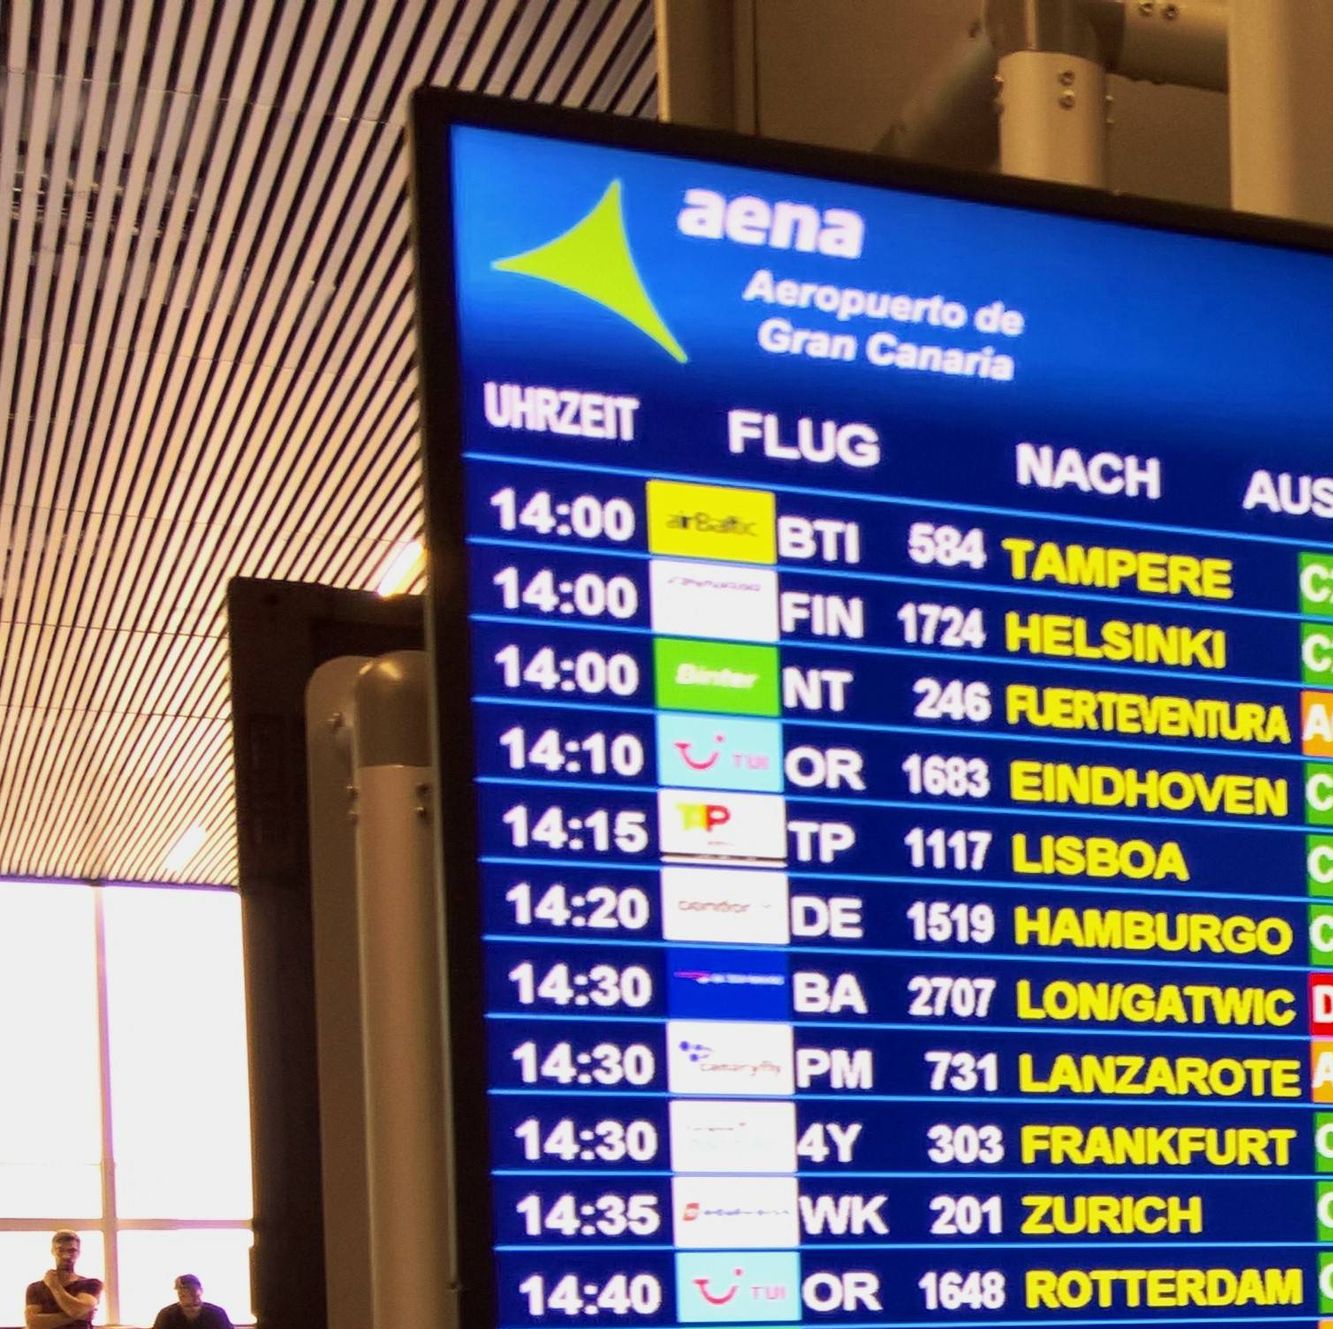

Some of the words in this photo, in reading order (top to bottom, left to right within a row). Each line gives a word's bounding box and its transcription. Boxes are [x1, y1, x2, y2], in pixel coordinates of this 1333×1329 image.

[676, 187, 866, 260] aena
[741, 269, 969, 330] Aeropuerto
[973, 301, 1026, 337] de
[757, 316, 859, 362] Gran
[865, 330, 1015, 382] Canaria
[483, 381, 641, 442] UHRZEIT
[727, 408, 882, 469] FLUG
[1015, 441, 1162, 500] NACH
[490, 487, 636, 542] 14:00
[778, 514, 861, 565] BTI
[907, 521, 988, 571] 584
[1000, 537, 1234, 600] TAMPERE
[492, 565, 639, 619] 14:00
[780, 590, 865, 639] FIN
[896, 601, 987, 649] 1724
[1004, 610, 1227, 670] HELSINKI
[502, 804, 649, 854] 14:15
[787, 819, 856, 864] TP
[904, 826, 993, 871] 1117
[1011, 832, 1191, 883] LISBOA
[512, 1040, 656, 1086] 14:30
[794, 1047, 874, 1090] PM
[923, 1050, 999, 1092] 731
[1018, 1052, 1303, 1098] LANZAROTE
